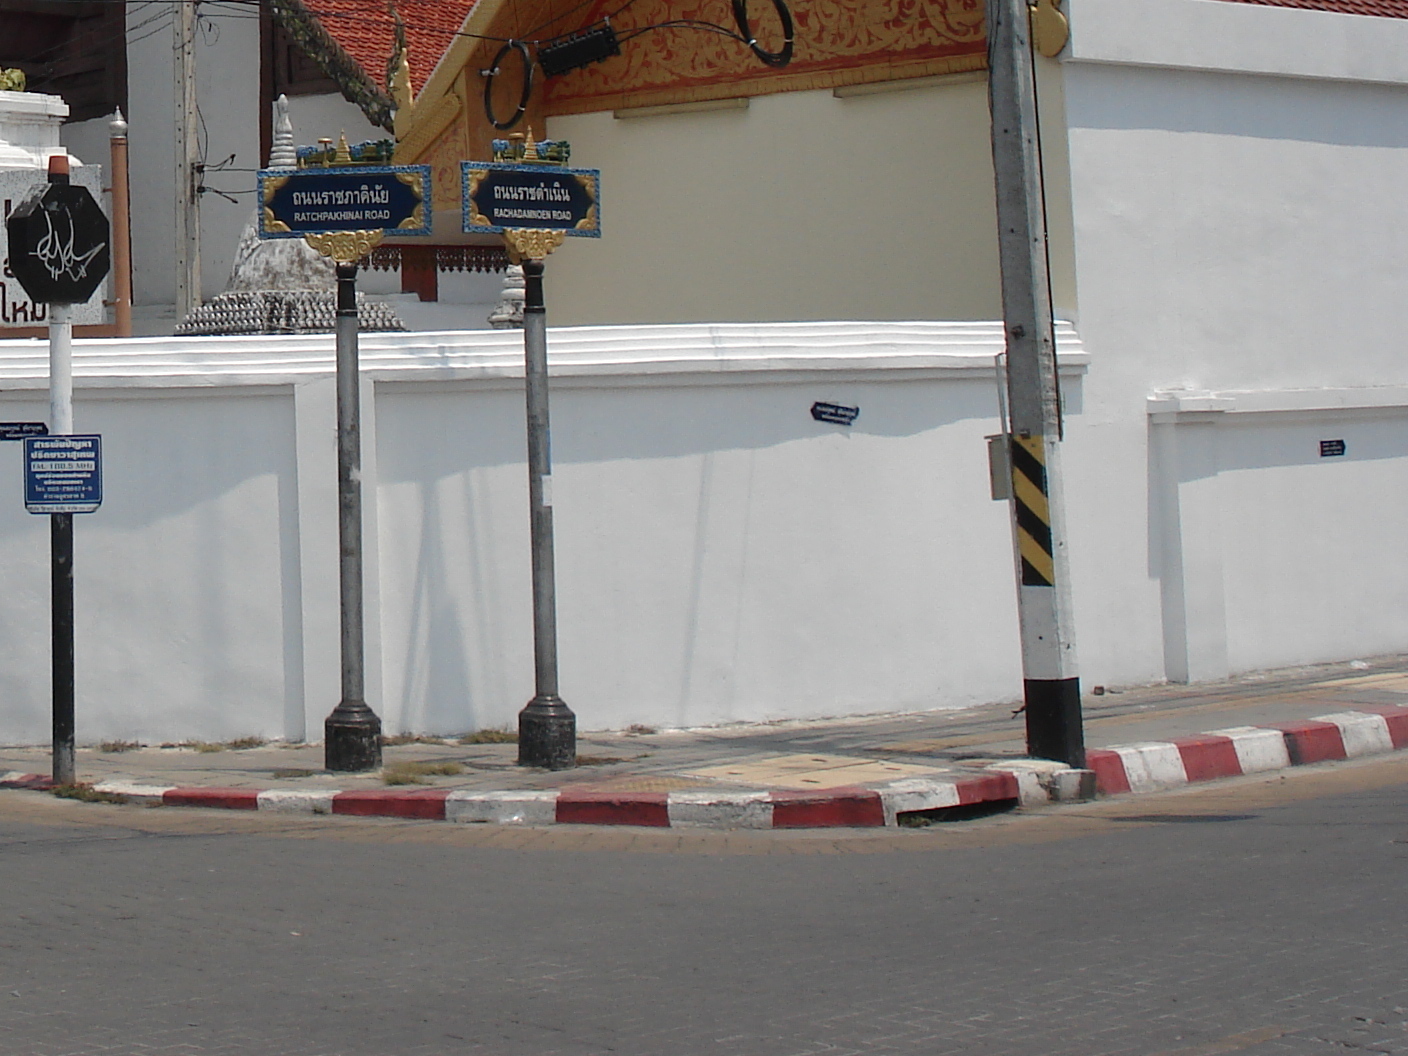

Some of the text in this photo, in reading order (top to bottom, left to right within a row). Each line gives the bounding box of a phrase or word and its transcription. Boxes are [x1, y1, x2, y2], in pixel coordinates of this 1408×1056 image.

[292, 184, 390, 206] ถนนราชภาคินัย
[493, 181, 571, 202] ถนนราชดำเนิน
[293, 209, 391, 222] RATCHPAKHINAI ROAD
[552, 210, 572, 221] ROAD
